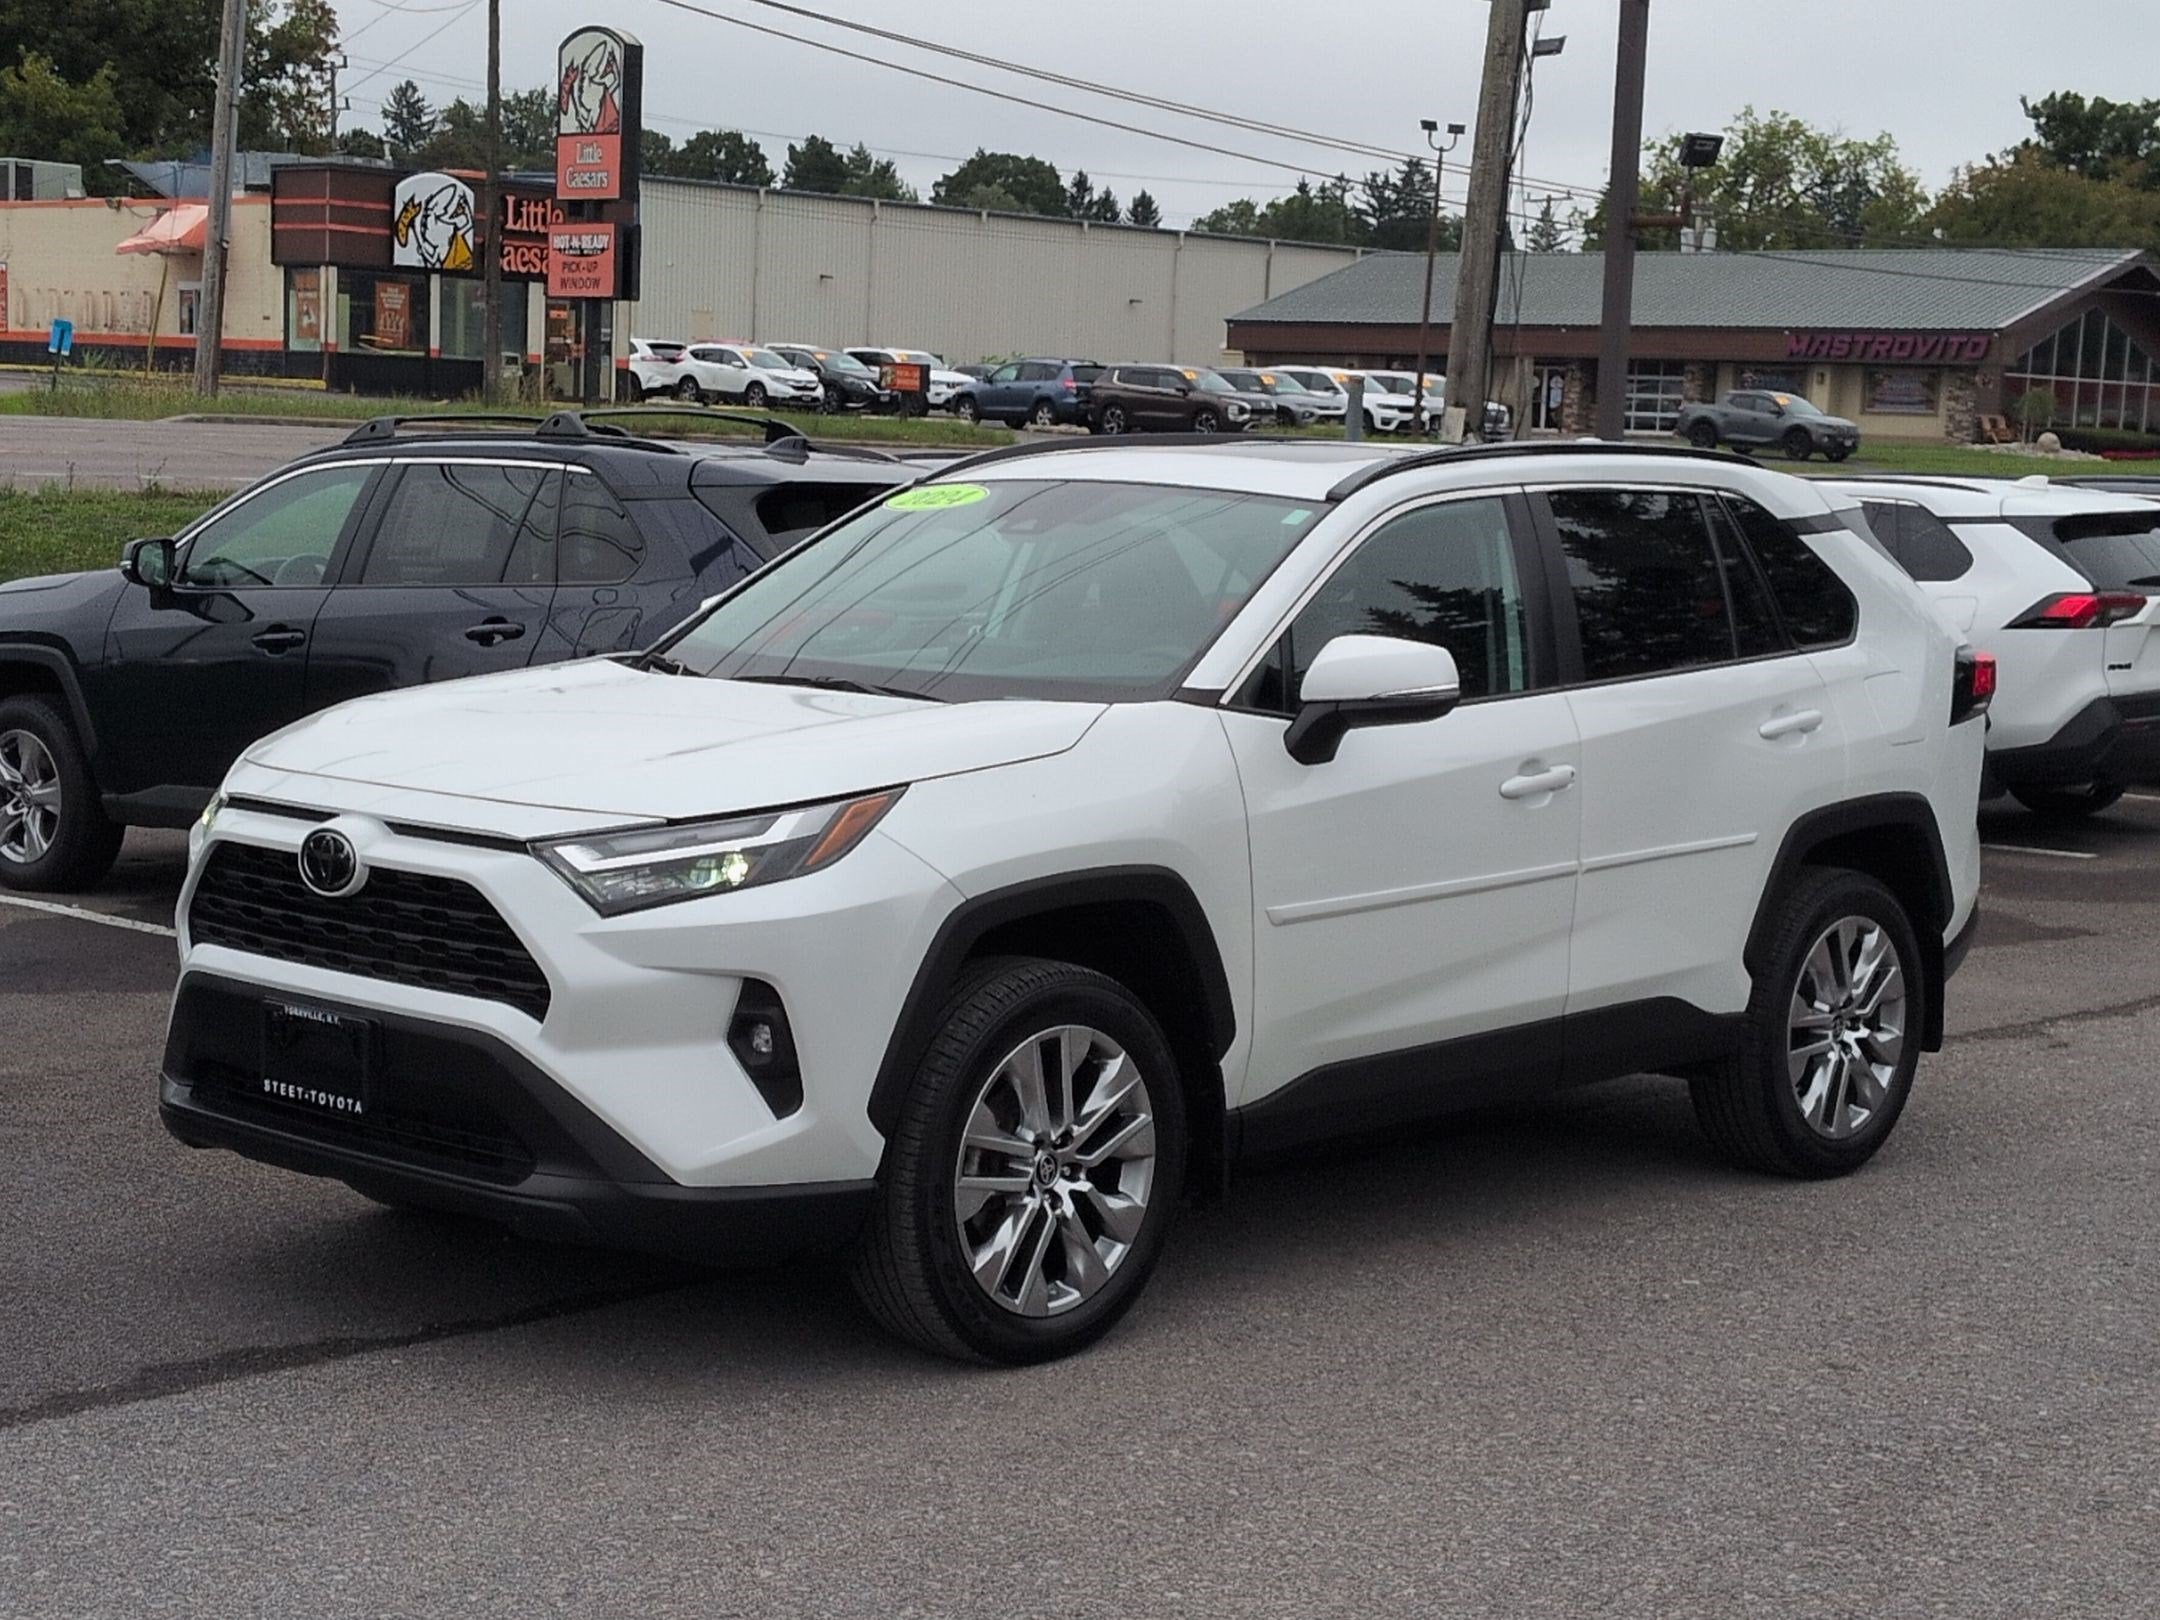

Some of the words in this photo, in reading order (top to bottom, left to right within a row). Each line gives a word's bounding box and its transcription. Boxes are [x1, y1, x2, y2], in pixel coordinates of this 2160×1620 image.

[576, 141, 602, 164] Little
[566, 167, 608, 188] Caesars
[505, 195, 564, 233] Little
[553, 234, 609, 248] HOT-N-READY
[562, 261, 598, 273] PICK-UP
[560, 277, 601, 289] WINDOW
[1786, 334, 1990, 360] MASTROVITO
